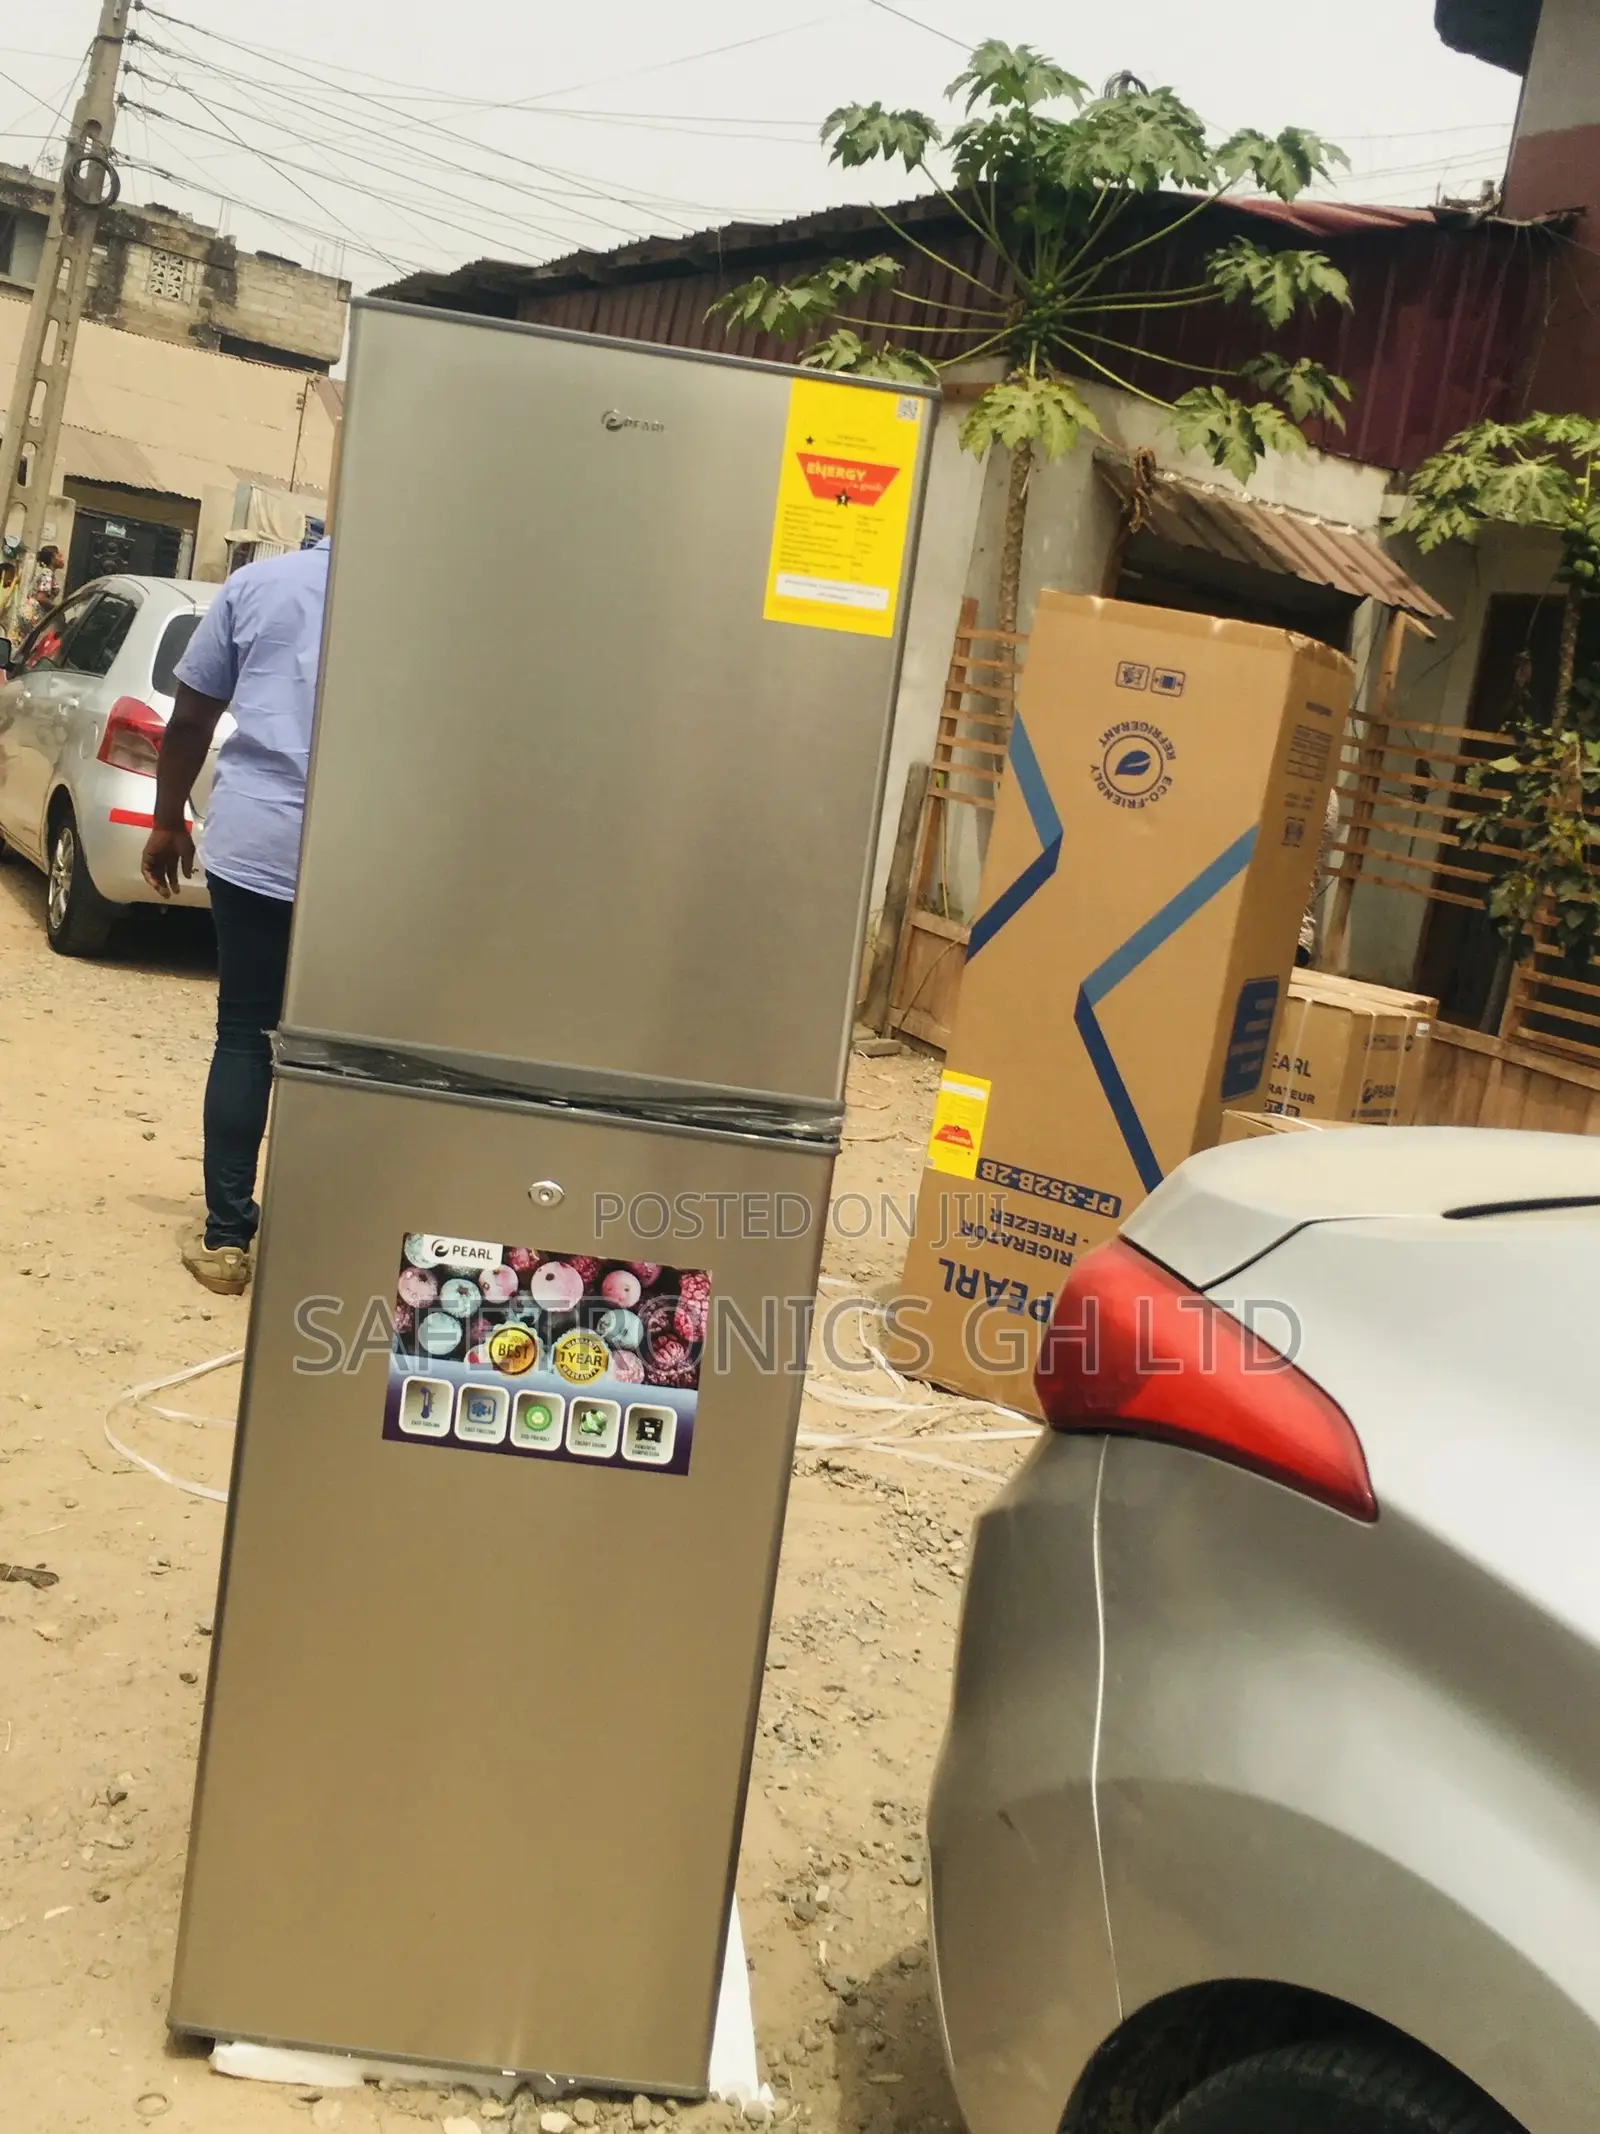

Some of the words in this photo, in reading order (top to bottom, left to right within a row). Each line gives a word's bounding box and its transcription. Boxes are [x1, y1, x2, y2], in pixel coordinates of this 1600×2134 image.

[1099, 720, 1176, 761] REFRIGERANT
[1090, 764, 1173, 809] ECO-FRIENDLY
[981, 1160, 1117, 1216] PF-352B-2B
[960, 1219, 1077, 1267] RIGERATOR
[990, 1207, 1078, 1247] FREEZER
[452, 1244, 494, 1260] PEARL
[938, 1257, 1055, 1323] PEARL
[498, 1342, 529, 1359] BEST
[568, 1352, 603, 1366] YEAR
[562, 1365, 599, 1380] WARRANTY
